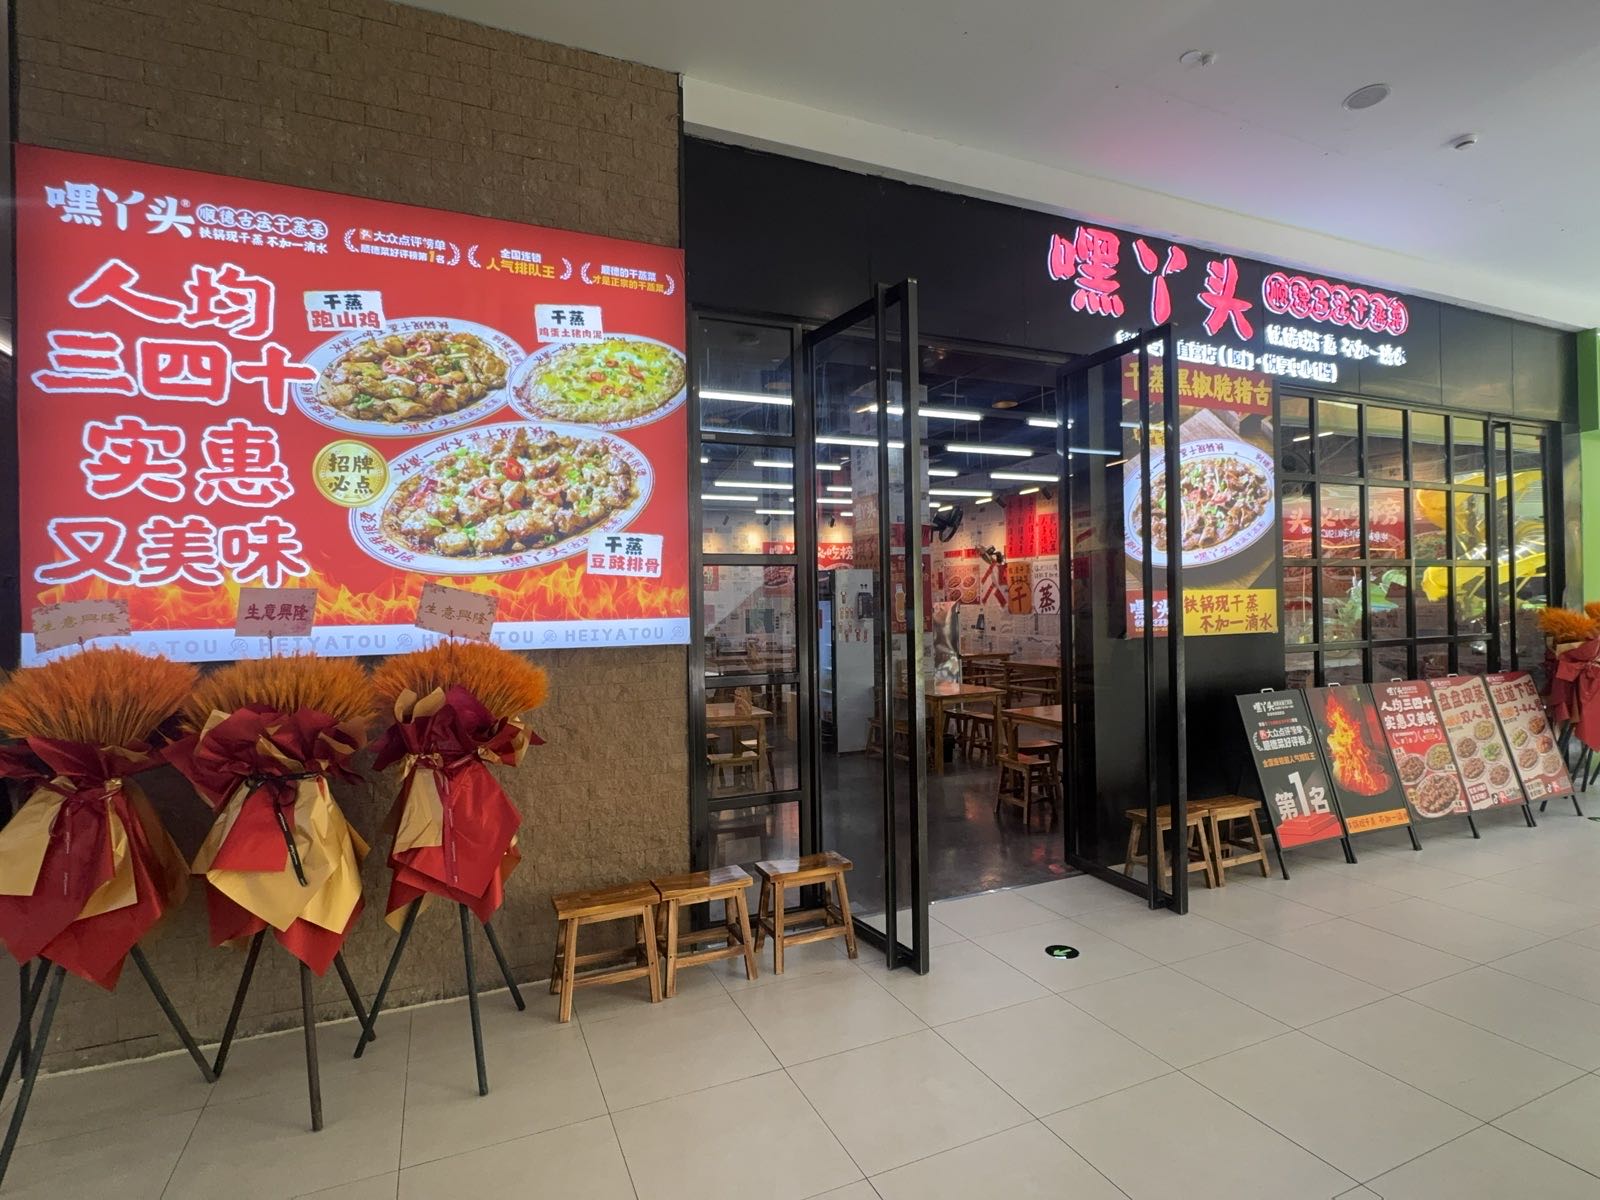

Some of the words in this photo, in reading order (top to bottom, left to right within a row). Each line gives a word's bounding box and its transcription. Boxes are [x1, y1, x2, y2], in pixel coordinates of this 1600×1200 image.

[45, 181, 195, 238] 嘿丫头
[197, 203, 328, 240] 顺德古法干蒸菜
[199, 227, 264, 247] 铁锅现干蒸
[266, 236, 328, 254] 不加一滴水
[500, 249, 541, 263] 全国连锁
[486, 257, 555, 279] 人气排队王
[601, 265, 656, 282] 顺德的干蒸菜
[592, 275, 665, 294] 才是正宗的干蒸菜
[1048, 226, 1253, 341] 嘿丫头
[69, 259, 275, 340] 人均
[324, 294, 363, 310] 干蒸
[1263, 273, 1408, 335] 顺德古法干蒸菜
[312, 311, 381, 329] 跑山鸡
[551, 310, 585, 326] 干蒸
[539, 328, 603, 340] 鸡蛋土猪肉泥
[31, 330, 320, 415] 三四十
[80, 415, 294, 507] 实惠
[329, 453, 374, 473] 招牌
[328, 475, 373, 494] 必点
[34, 515, 310, 589] 又美味
[605, 536, 643, 555] 干蒸
[591, 554, 659, 573] 豆豉排骨
[1039, 584, 1057, 613] 蒸
[1184, 594, 1259, 614] 铁锅现干蒸
[245, 603, 308, 622] 生意興隆
[424, 601, 488, 626] 生意興隆
[1200, 612, 1273, 631] 不加一滴水
[564, 626, 664, 643] HEIYATOU
[1381, 696, 1433, 712] 人均三四十
[1384, 711, 1439, 730] 实惠又美味
[1275, 771, 1330, 821] 第1名
